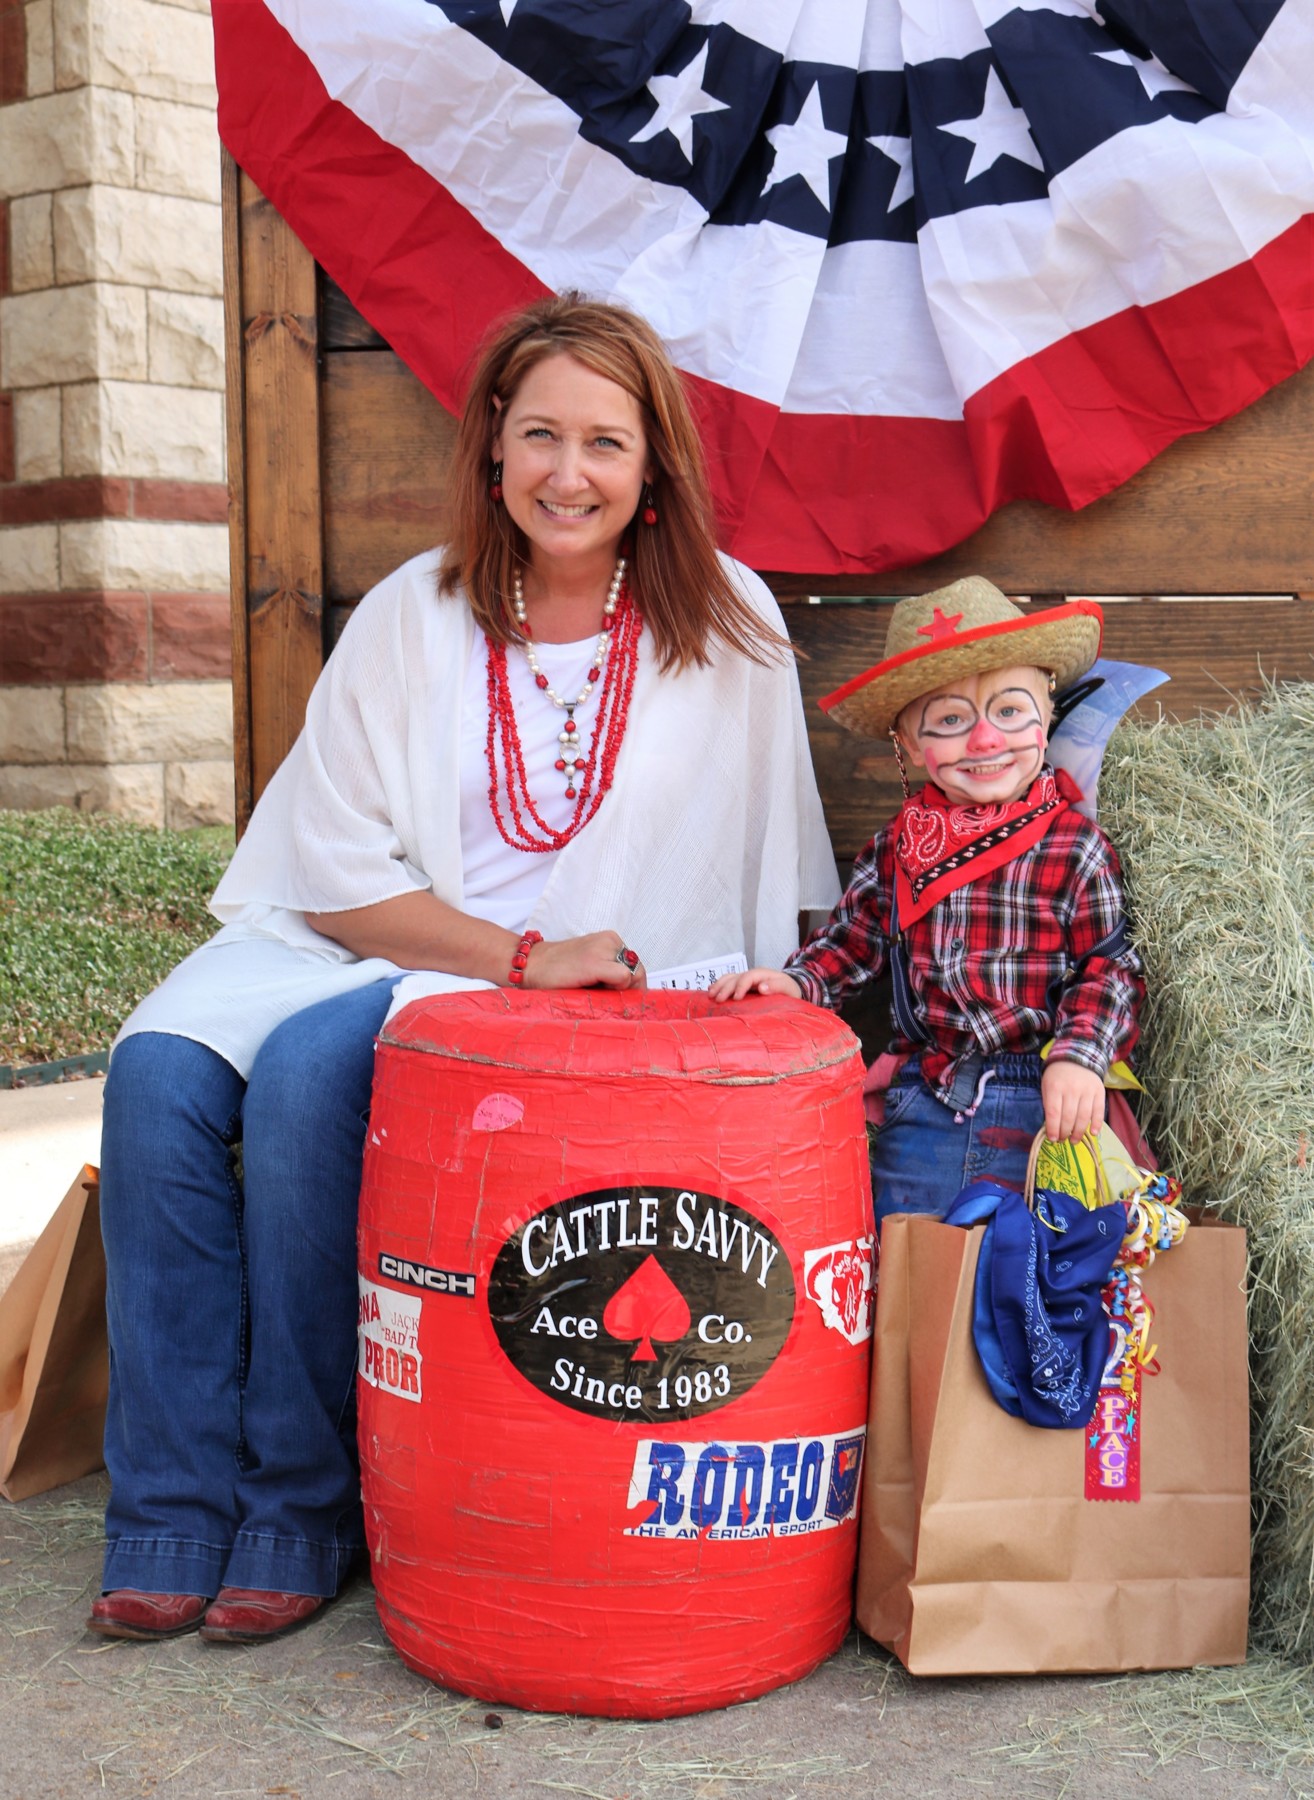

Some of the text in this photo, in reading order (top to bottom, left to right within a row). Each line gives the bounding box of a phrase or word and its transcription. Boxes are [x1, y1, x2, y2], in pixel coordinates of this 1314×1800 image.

[521, 1192, 778, 1289] CATTLE SAVVY
[381, 1256, 475, 1295] CINCH
[391, 1312, 419, 1331] JACK
[530, 1307, 752, 1344] Ace Co.
[550, 1358, 731, 1409] Since 1983
[1101, 1397, 1127, 1487] PLACE
[645, 1440, 824, 1527] RODEO
[780, 1519, 823, 1535] SPORT
